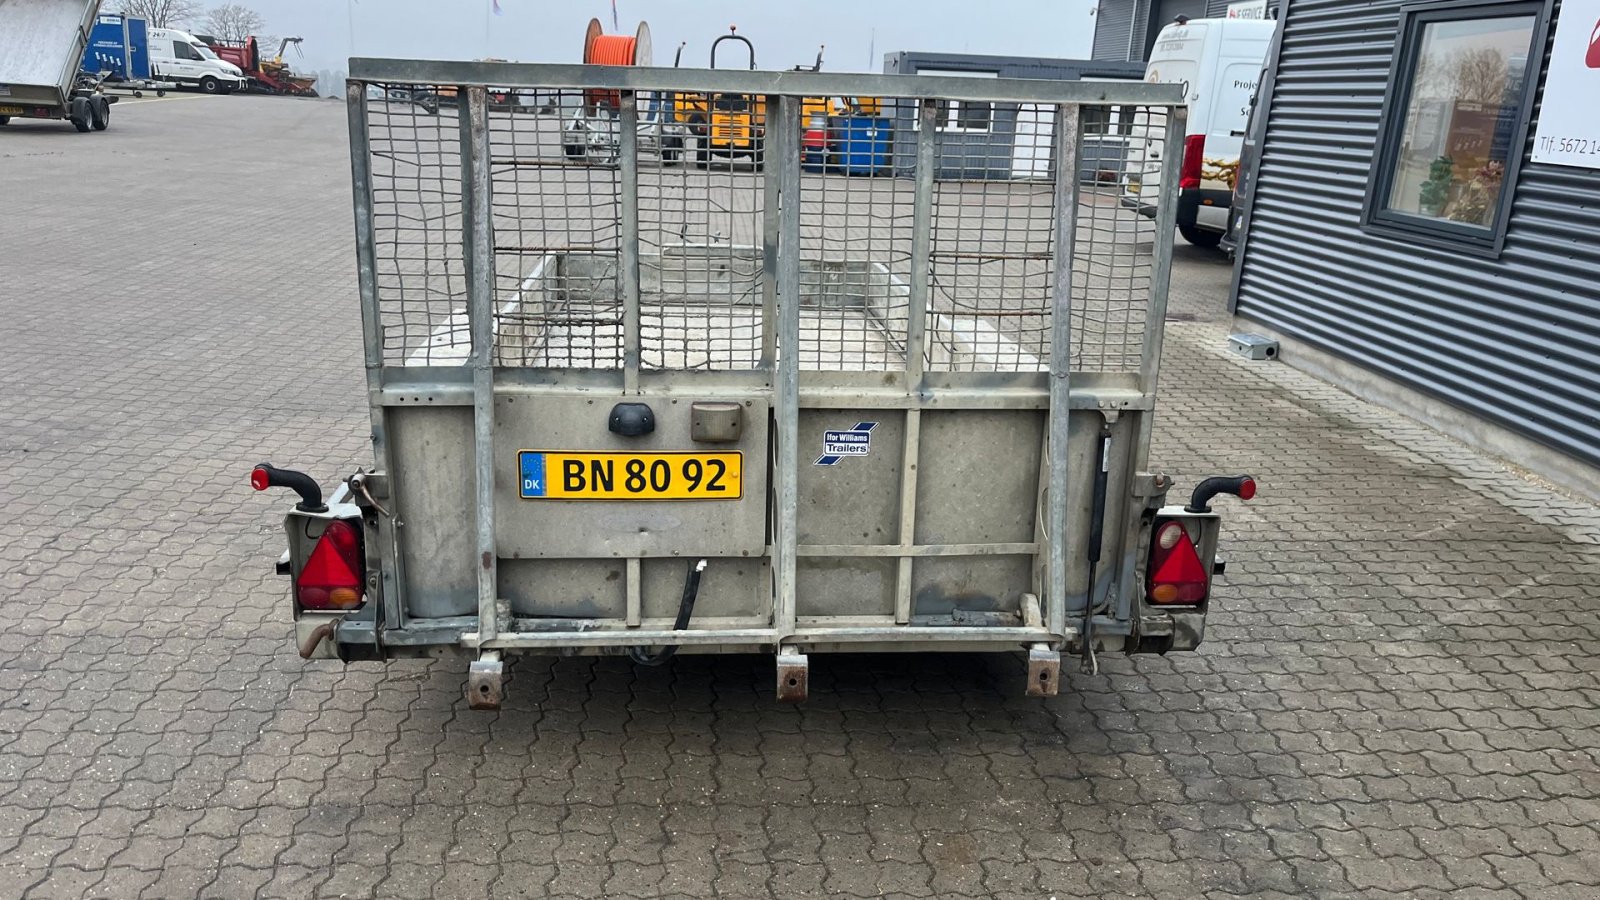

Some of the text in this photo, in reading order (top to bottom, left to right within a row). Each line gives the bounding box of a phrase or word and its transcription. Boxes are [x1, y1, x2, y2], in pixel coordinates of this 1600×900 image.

[1541, 136, 1555, 154] Tlf.
[1559, 138, 1588, 154] 5672
[827, 433, 868, 442] Ifor Williams
[827, 444, 867, 452] Trailers
[563, 458, 727, 493] BN 80 92
[524, 479, 540, 490] DK
